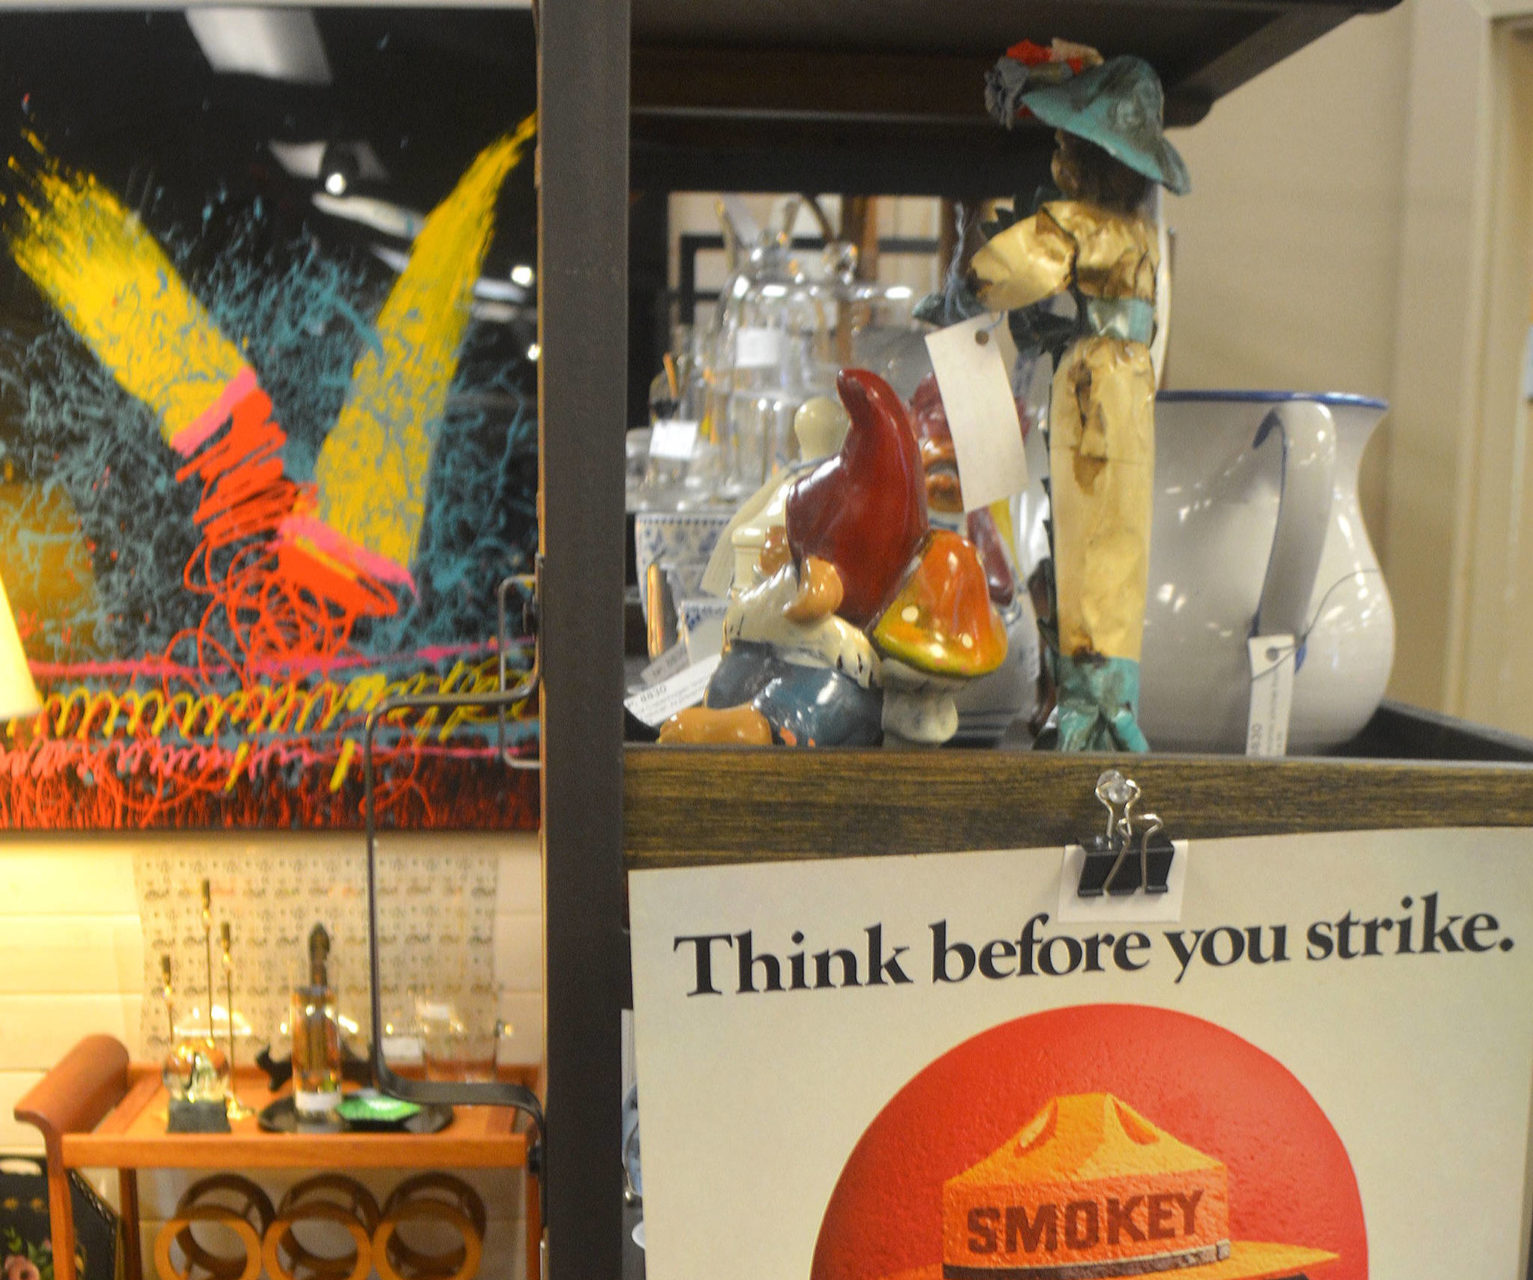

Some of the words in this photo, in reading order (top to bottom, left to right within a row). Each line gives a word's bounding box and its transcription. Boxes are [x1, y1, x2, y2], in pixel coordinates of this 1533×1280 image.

[674, 924, 914, 997] Think
[929, 913, 1151, 983] before
[1163, 925, 1290, 984] you
[1306, 891, 1515, 961] strike.
[966, 1189, 1205, 1255] SMOKEY
